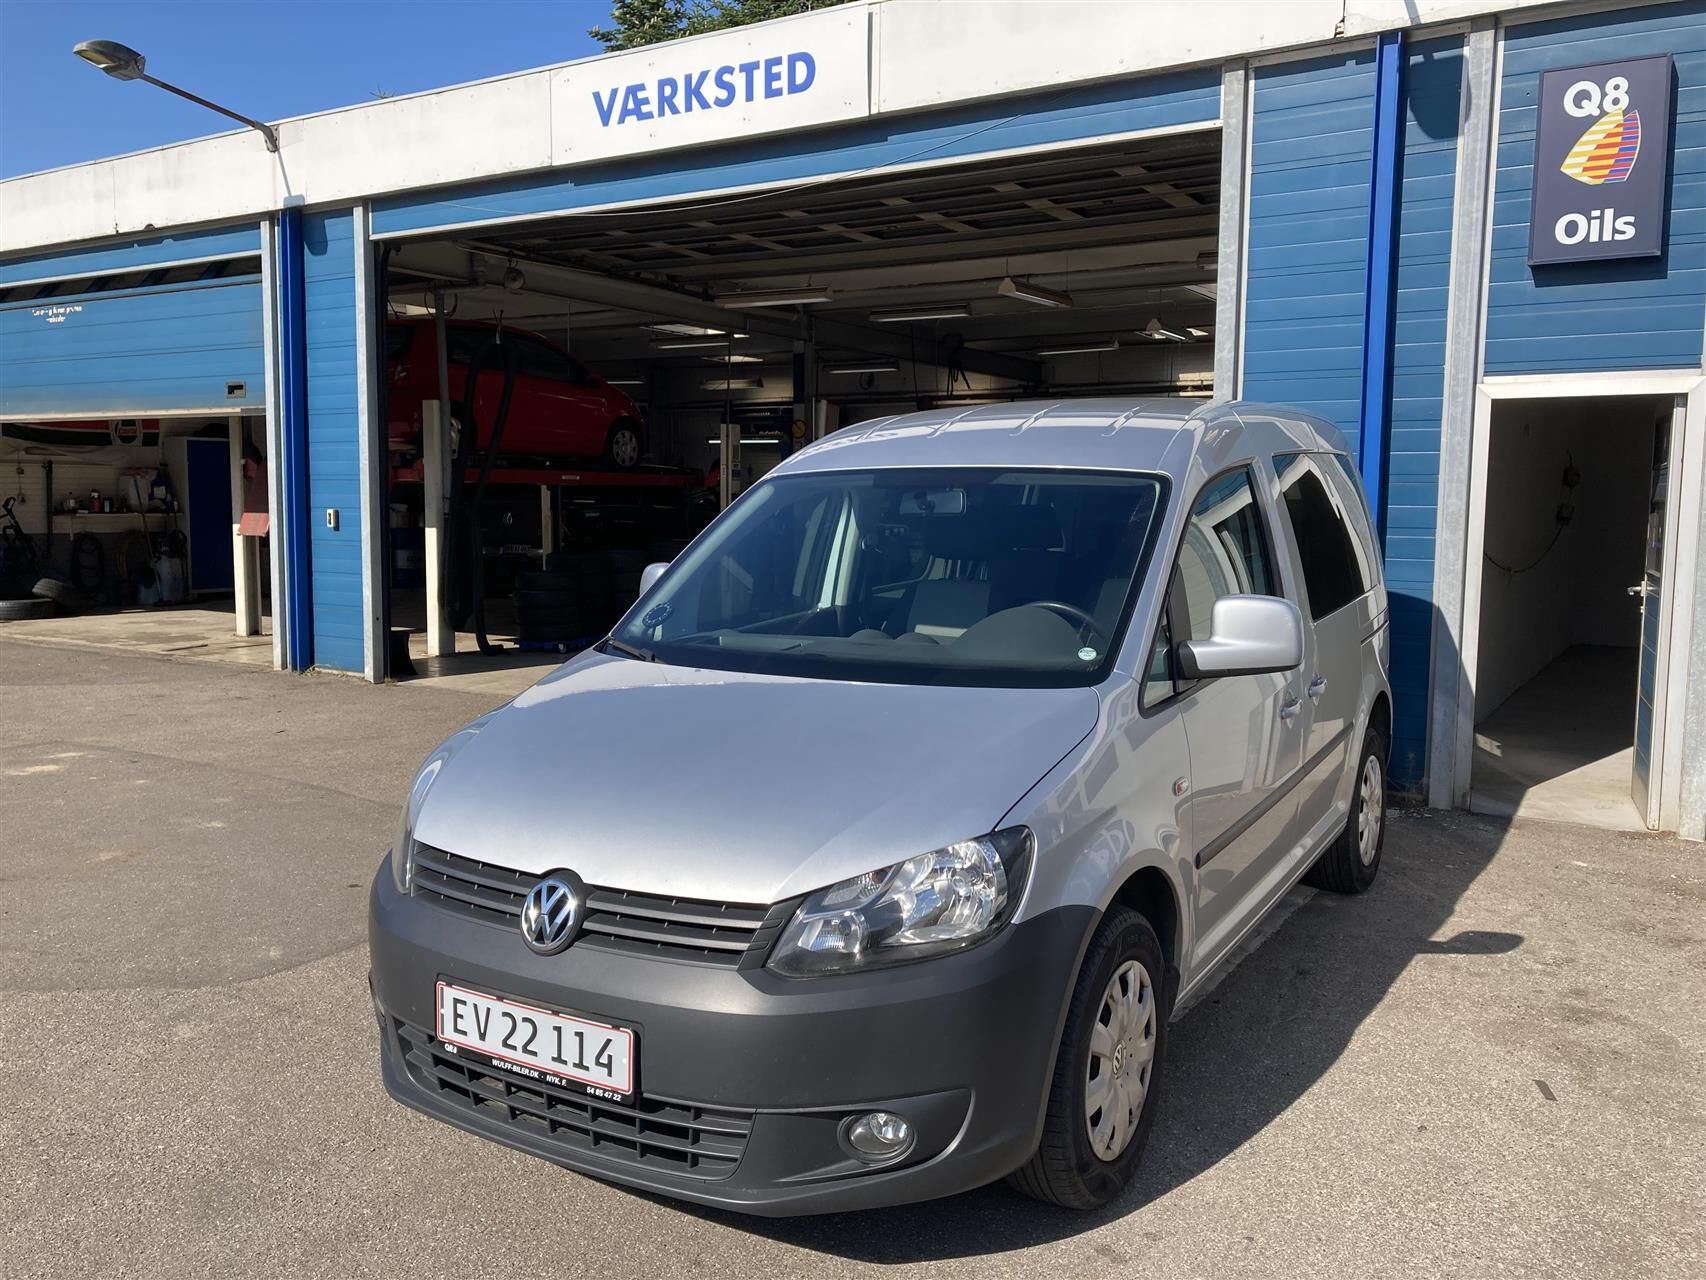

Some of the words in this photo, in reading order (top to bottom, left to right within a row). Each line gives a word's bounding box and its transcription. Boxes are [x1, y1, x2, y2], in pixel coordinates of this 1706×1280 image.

[592, 51, 816, 127] VÆRKSTED
[1563, 76, 1630, 117] Q8
[1554, 208, 1636, 245] Oils
[452, 996, 491, 1042] EV
[501, 1011, 538, 1057] 22
[551, 1025, 614, 1078] 114
